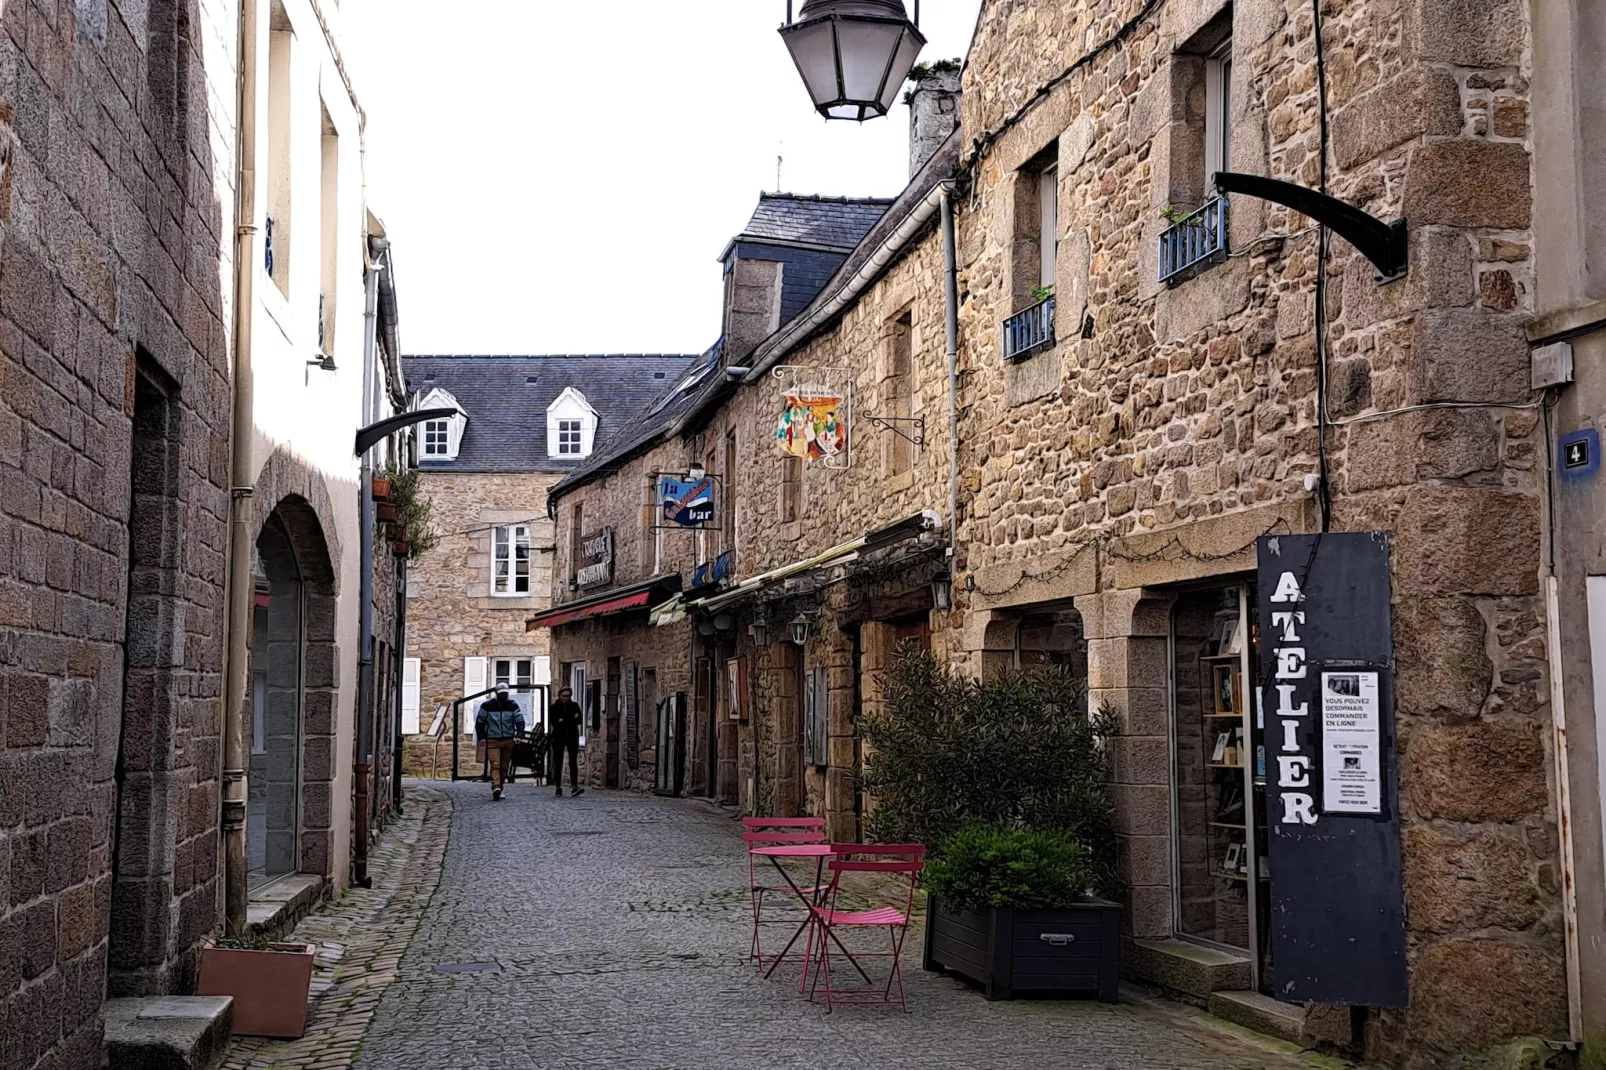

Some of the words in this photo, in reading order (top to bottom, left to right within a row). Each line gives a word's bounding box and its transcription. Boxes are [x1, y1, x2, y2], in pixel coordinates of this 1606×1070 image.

[1571, 445, 1580, 462] 4
[664, 482, 678, 494] la
[688, 509, 711, 520] bar
[1270, 571, 1318, 825] ATELIER
